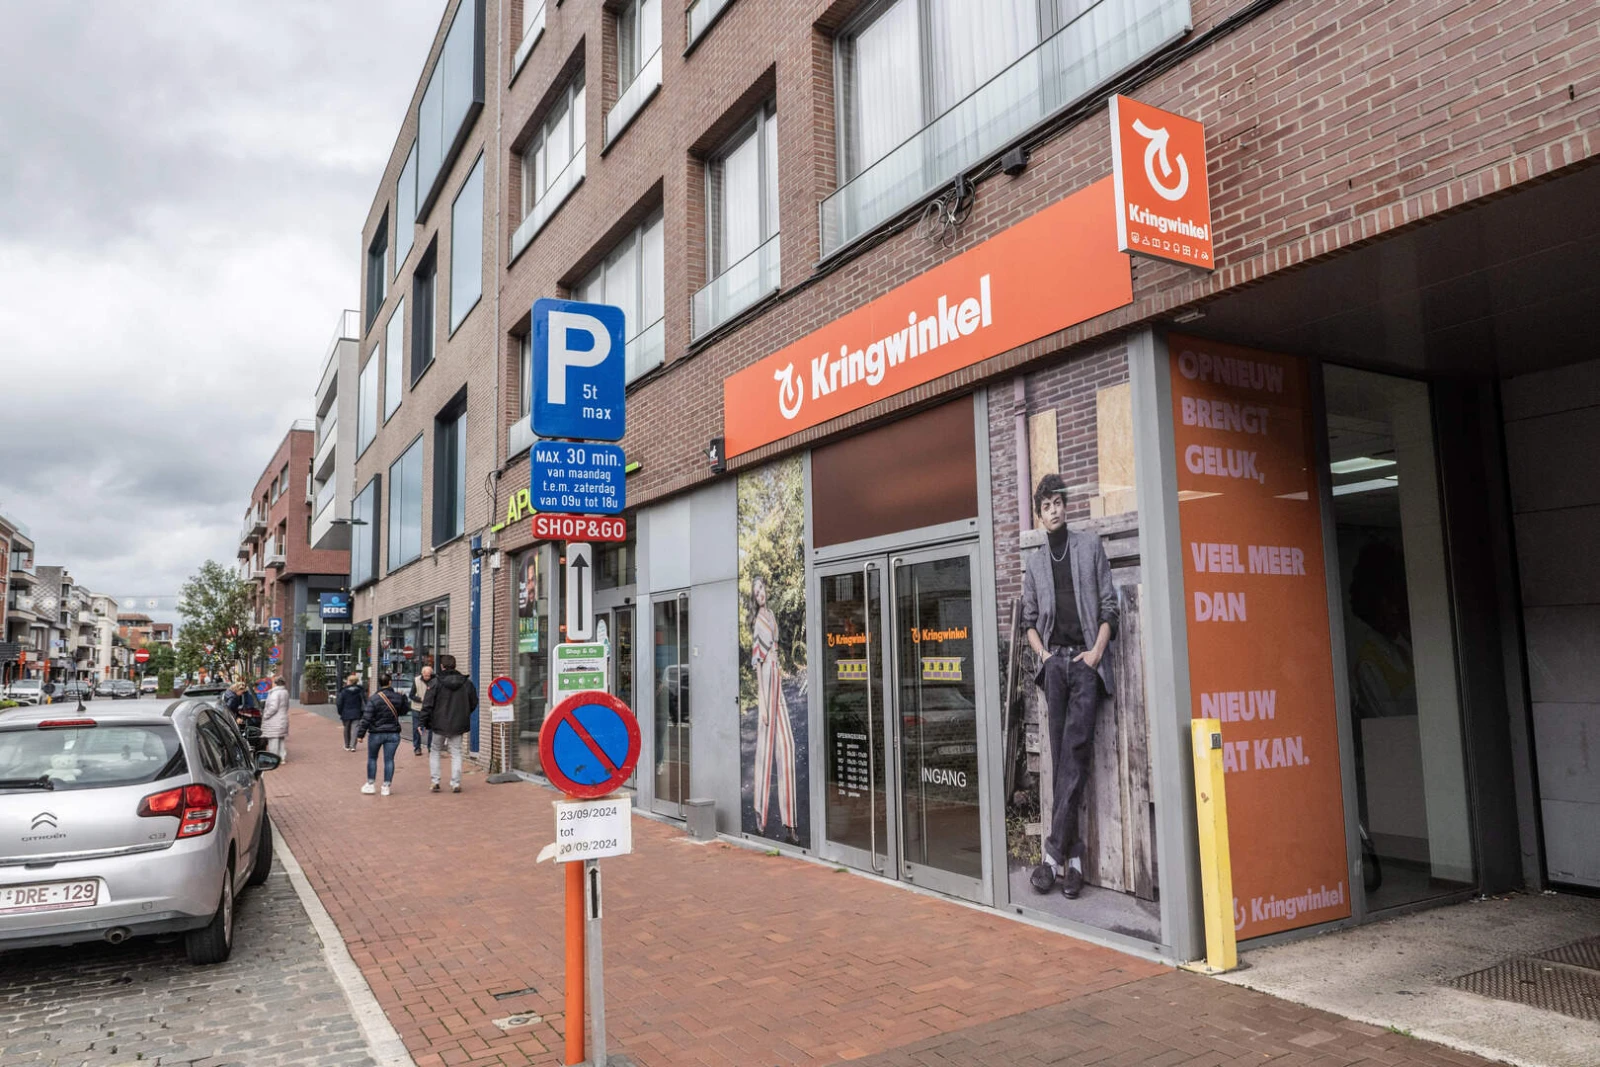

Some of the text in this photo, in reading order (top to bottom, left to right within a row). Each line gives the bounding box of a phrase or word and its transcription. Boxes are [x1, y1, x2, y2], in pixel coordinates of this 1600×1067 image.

[1128, 203, 1209, 241] Kringwinkel
[811, 273, 992, 400] Kringwinkel
[547, 310, 612, 405] P
[1178, 350, 1284, 393] OPNIEUW
[582, 384, 598, 400] 5t
[582, 406, 612, 420] max
[1181, 396, 1269, 436] BRENGT
[536, 448, 622, 467] MAX. 30 min.
[1185, 444, 1265, 484] GELUK,
[547, 468, 611, 482] van maandag
[543, 481, 616, 496] t.e.m. zaterdag
[540, 495, 618, 509] van 09u tot 18u
[536, 518, 624, 539] SHOP&GO
[1190, 542, 1306, 576] VEEL MEER
[1193, 591, 1247, 622] DAN
[836, 632, 872, 646] Kringwinkl
[922, 626, 968, 643] Kringwinkel
[1200, 689, 1276, 723] NIEUW
[1223, 736, 1310, 773] AT KAN.
[921, 767, 967, 787] INGANG
[560, 807, 617, 820] 23/09/2024
[560, 828, 574, 837] tot
[1251, 881, 1344, 923] Kringwinkel
